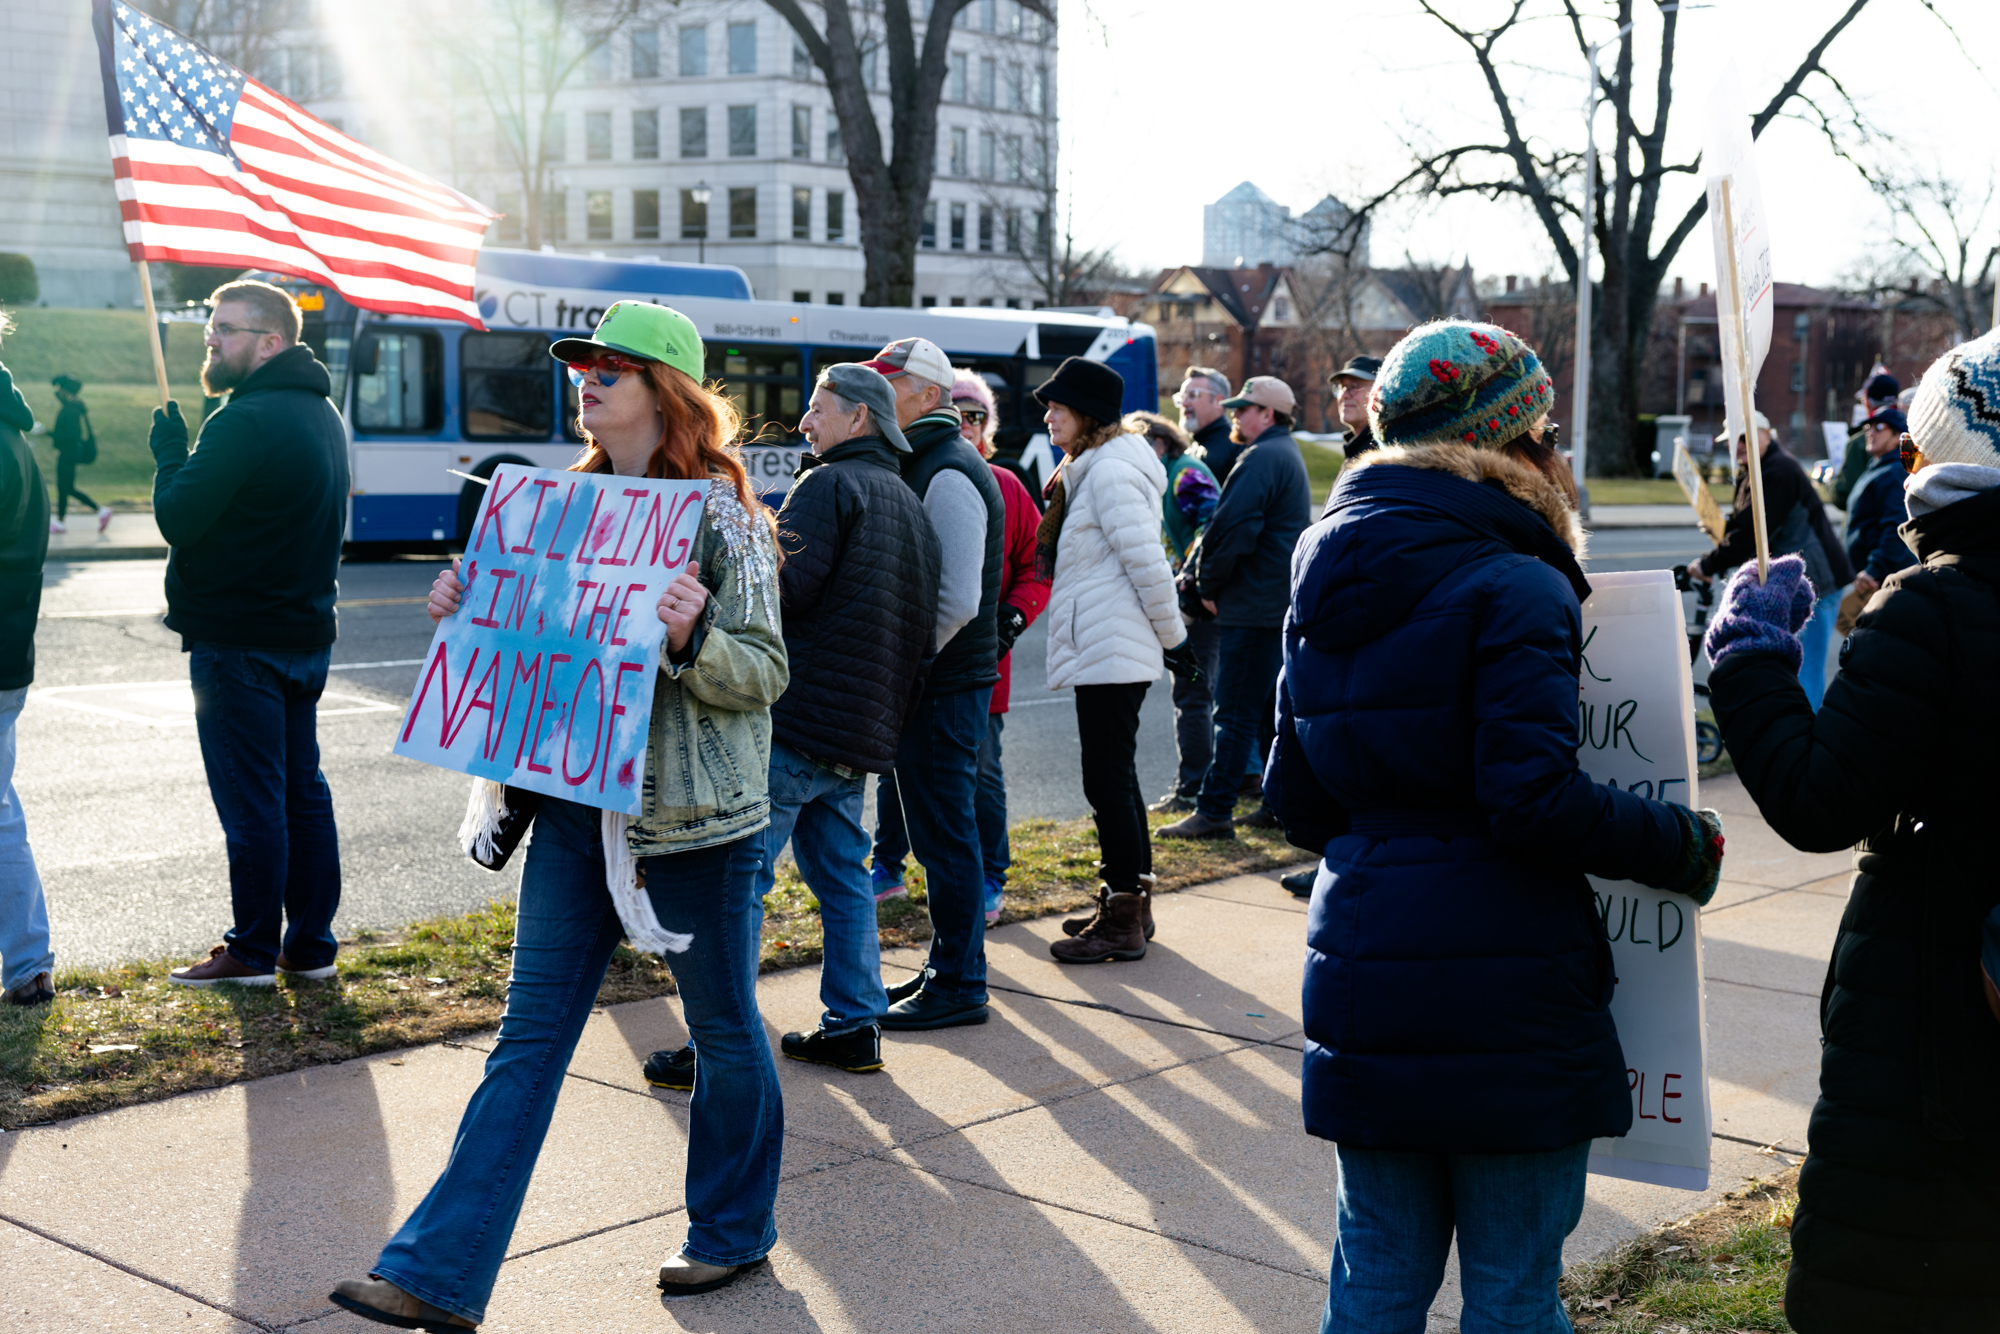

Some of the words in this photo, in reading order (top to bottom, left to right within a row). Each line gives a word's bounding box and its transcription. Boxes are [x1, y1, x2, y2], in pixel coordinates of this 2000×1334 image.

[504, 290, 548, 327] CT
[473, 472, 703, 569] KILLING
[471, 568, 537, 632] IN
[568, 580, 647, 647] THE
[402, 641, 572, 775] NAME
[562, 657, 644, 793] OF
